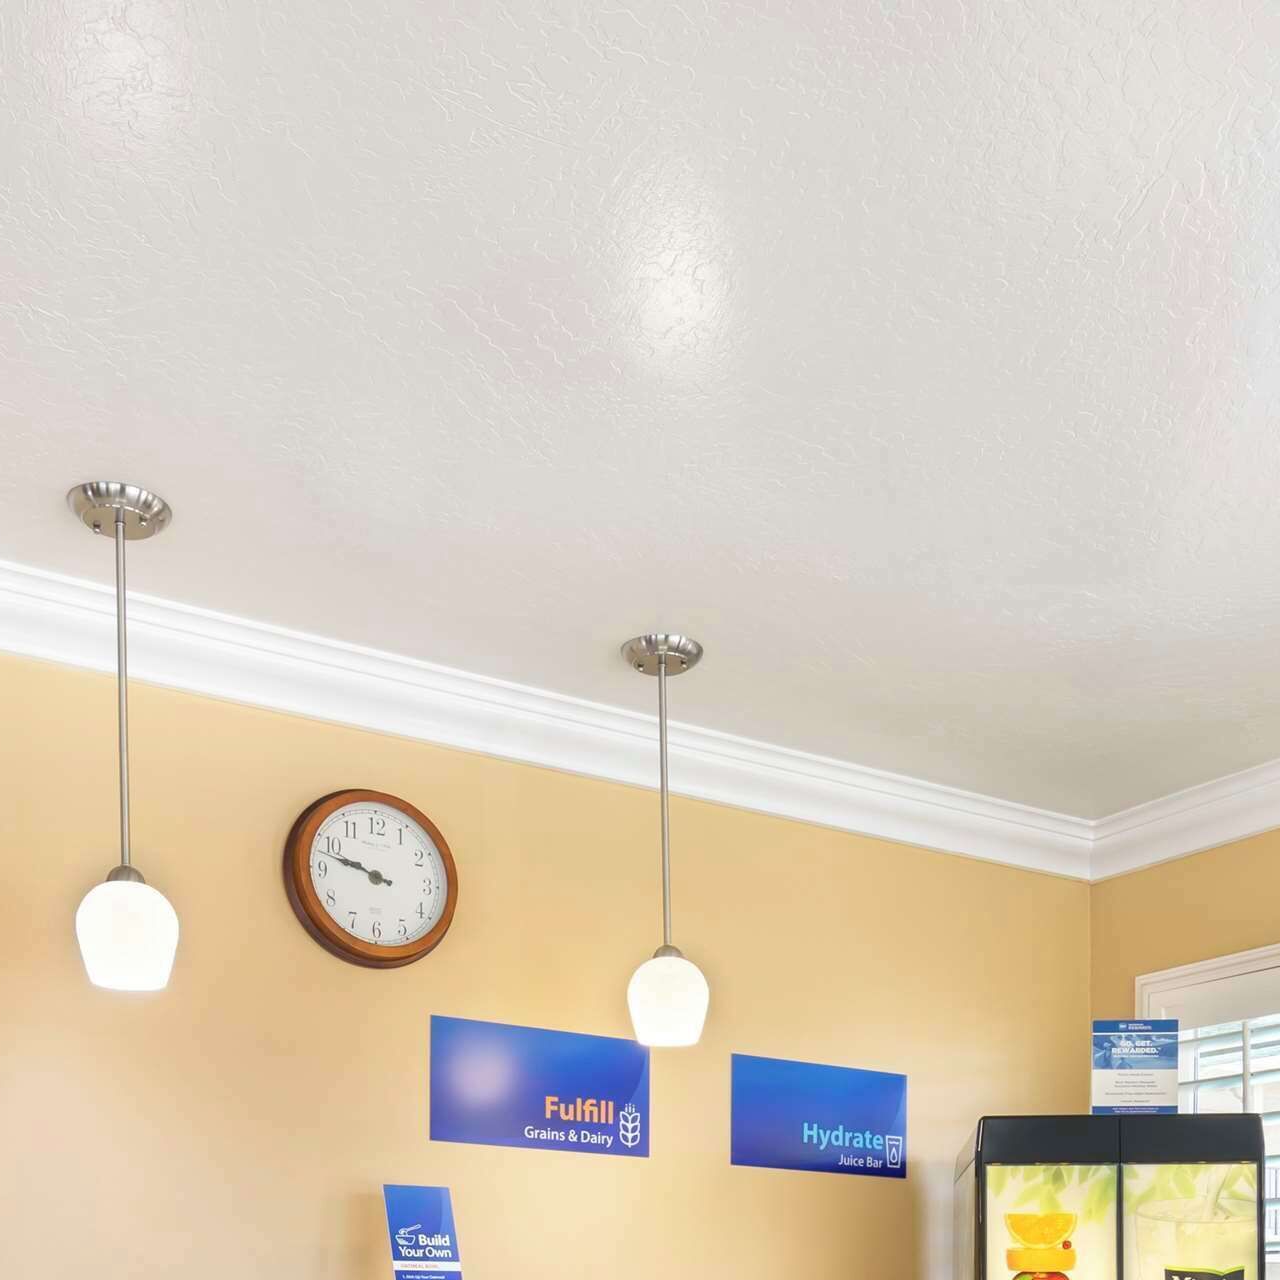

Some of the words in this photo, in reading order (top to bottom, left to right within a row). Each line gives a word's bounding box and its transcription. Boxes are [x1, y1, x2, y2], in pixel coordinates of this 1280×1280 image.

[344, 820, 357, 839] 11
[369, 817, 386, 836] 12
[397, 828, 403, 845] 1
[326, 836, 341, 855] 10
[414, 850, 424, 867] 2
[318, 861, 328, 879] 9
[423, 879, 432, 896] 3
[326, 889, 336, 907] 8
[416, 902, 426, 919] 4
[348, 912, 357, 929] 7
[398, 919, 407, 936] 5
[372, 920, 382, 939] 6
[544, 1095, 614, 1124] Fulfill
[524, 1125, 565, 1142] Grains
[567, 1129, 578, 1142] &
[581, 1131, 613, 1148] Dairy
[803, 1122, 884, 1150] Hydrate
[838, 1154, 864, 1167] Juice
[866, 1156, 883, 1169] Bar
[418, 1234, 450, 1246] Build
[398, 1246, 425, 1258] Your
[425, 1247, 452, 1258] Own
